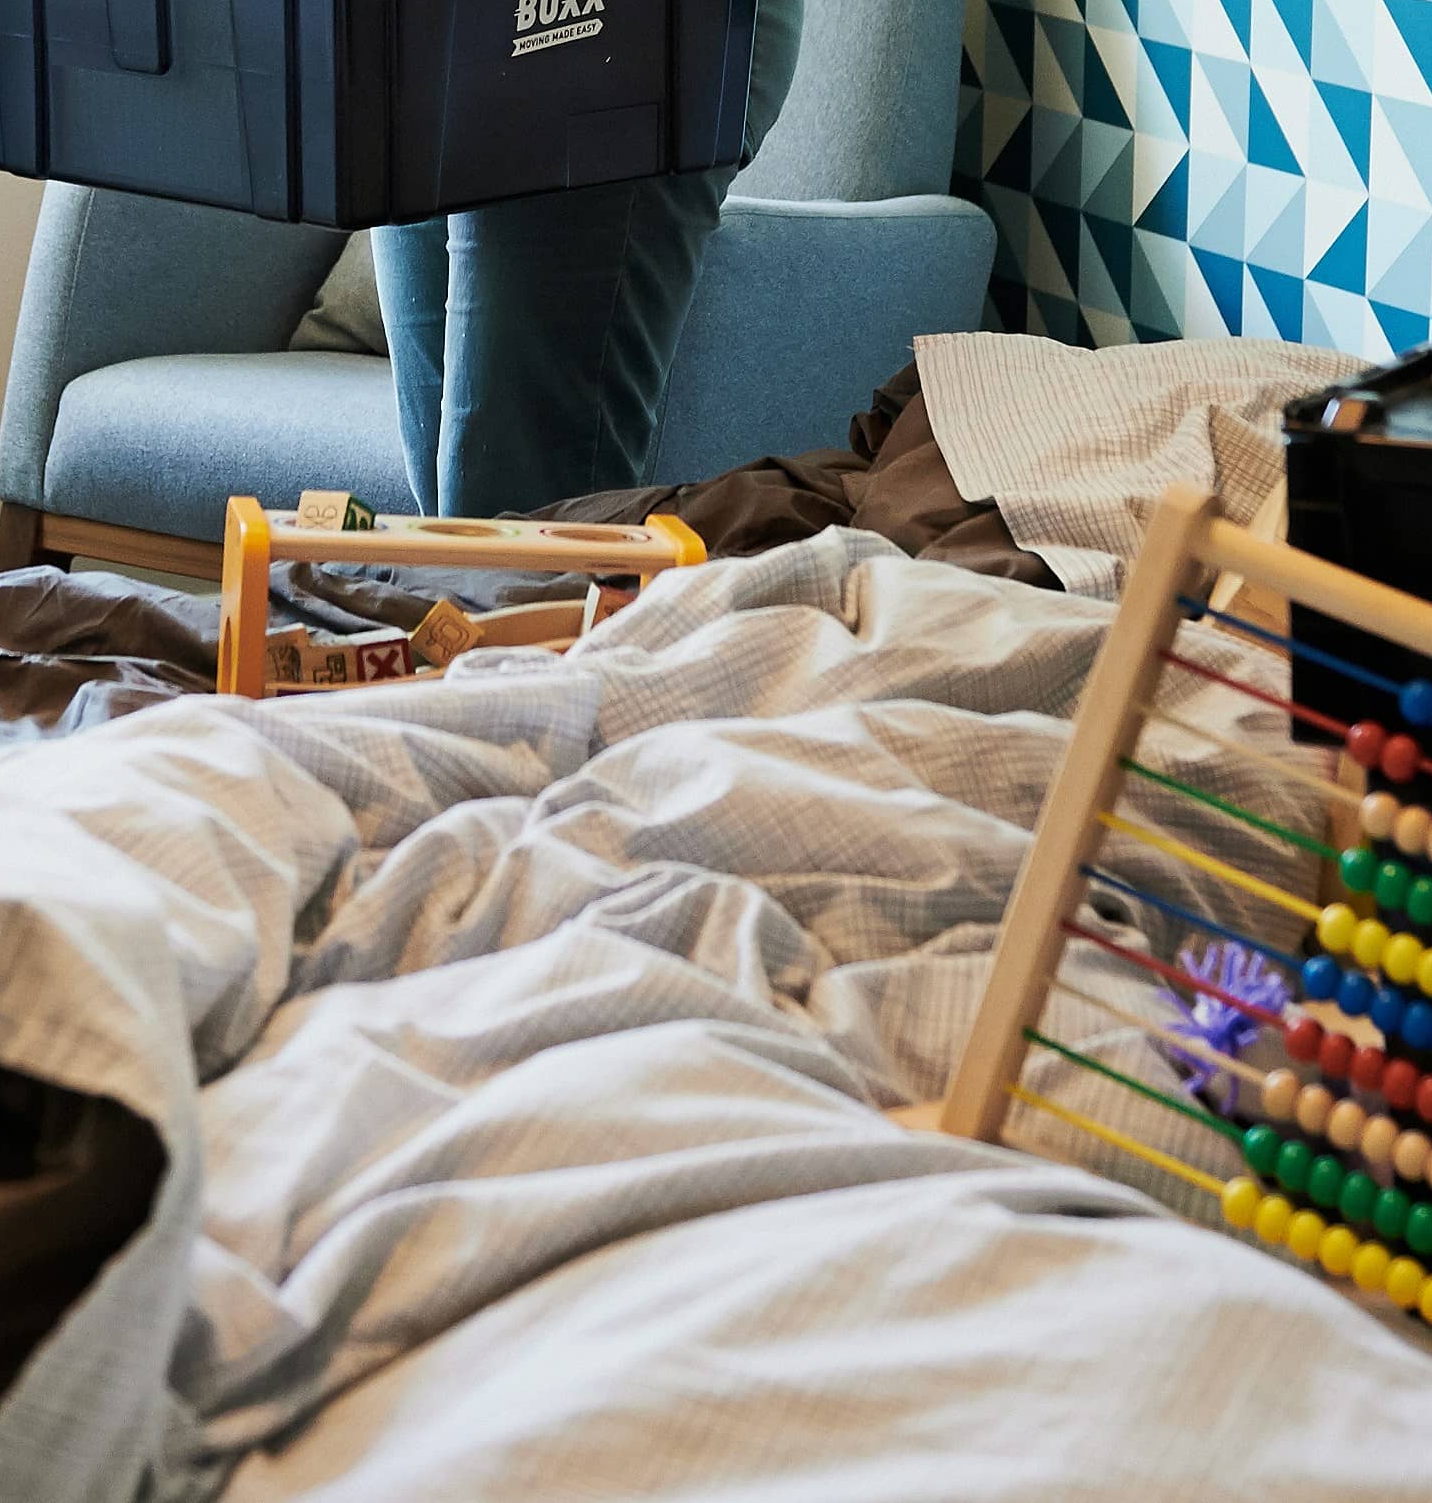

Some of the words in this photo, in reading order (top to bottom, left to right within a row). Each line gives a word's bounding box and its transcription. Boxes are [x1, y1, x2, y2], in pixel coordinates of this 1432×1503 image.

[519, 35, 551, 51] MOVING
[552, 28, 575, 43] MADE
[577, 21, 597, 35] EASY
